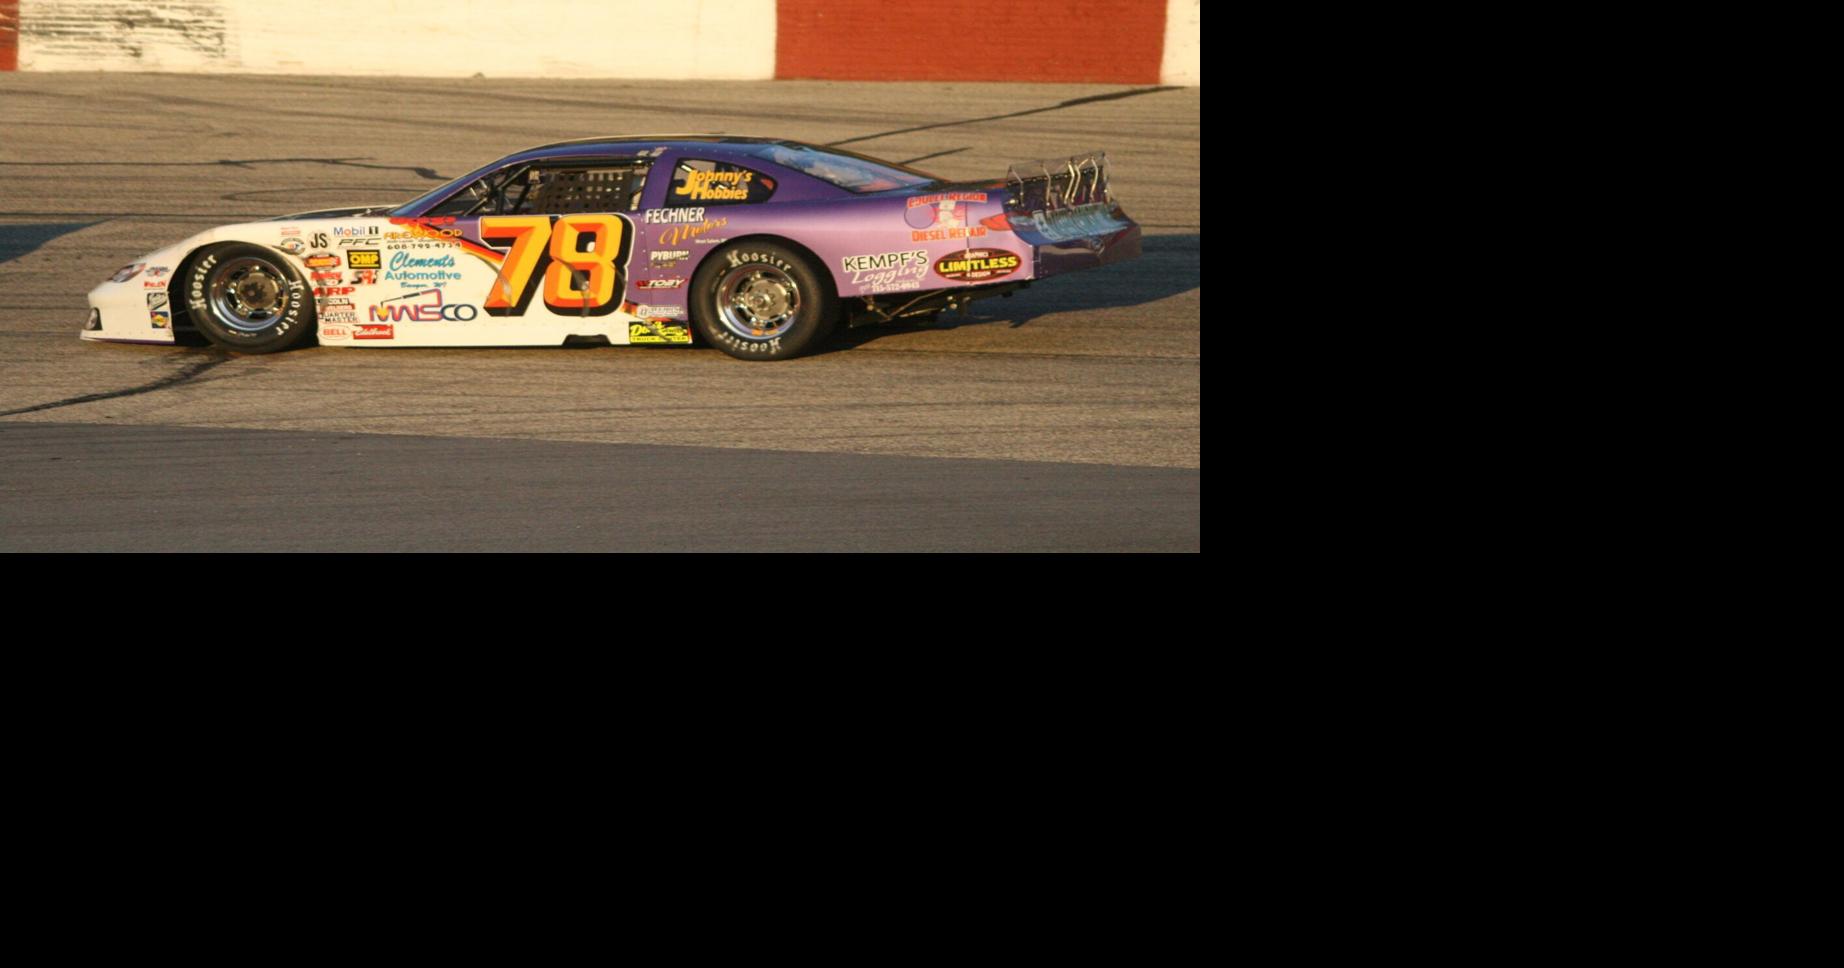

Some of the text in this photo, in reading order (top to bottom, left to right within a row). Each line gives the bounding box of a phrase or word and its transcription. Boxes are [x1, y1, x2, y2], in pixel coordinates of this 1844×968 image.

[675, 169, 753, 195] Johnny's
[690, 180, 749, 200] Hobbies
[645, 207, 706, 224] FECHNER
[310, 233, 329, 249] JS
[333, 226, 365, 237] Mobil
[911, 230, 946, 242] DIESEL
[338, 238, 382, 246] PFC
[350, 255, 379, 265] OMP
[389, 251, 456, 271] Clements
[480, 212, 635, 317] 78
[727, 249, 792, 272] Hoosier
[844, 251, 928, 272] KEMPF'S
[939, 256, 1018, 273] LIMITLESS
[189, 254, 217, 310] Hoosier
[384, 270, 462, 280] Automotive
[852, 264, 929, 284] Logging
[313, 287, 356, 297] ARP
[275, 279, 305, 336] Hoosier
[716, 331, 782, 355] Hoosier
